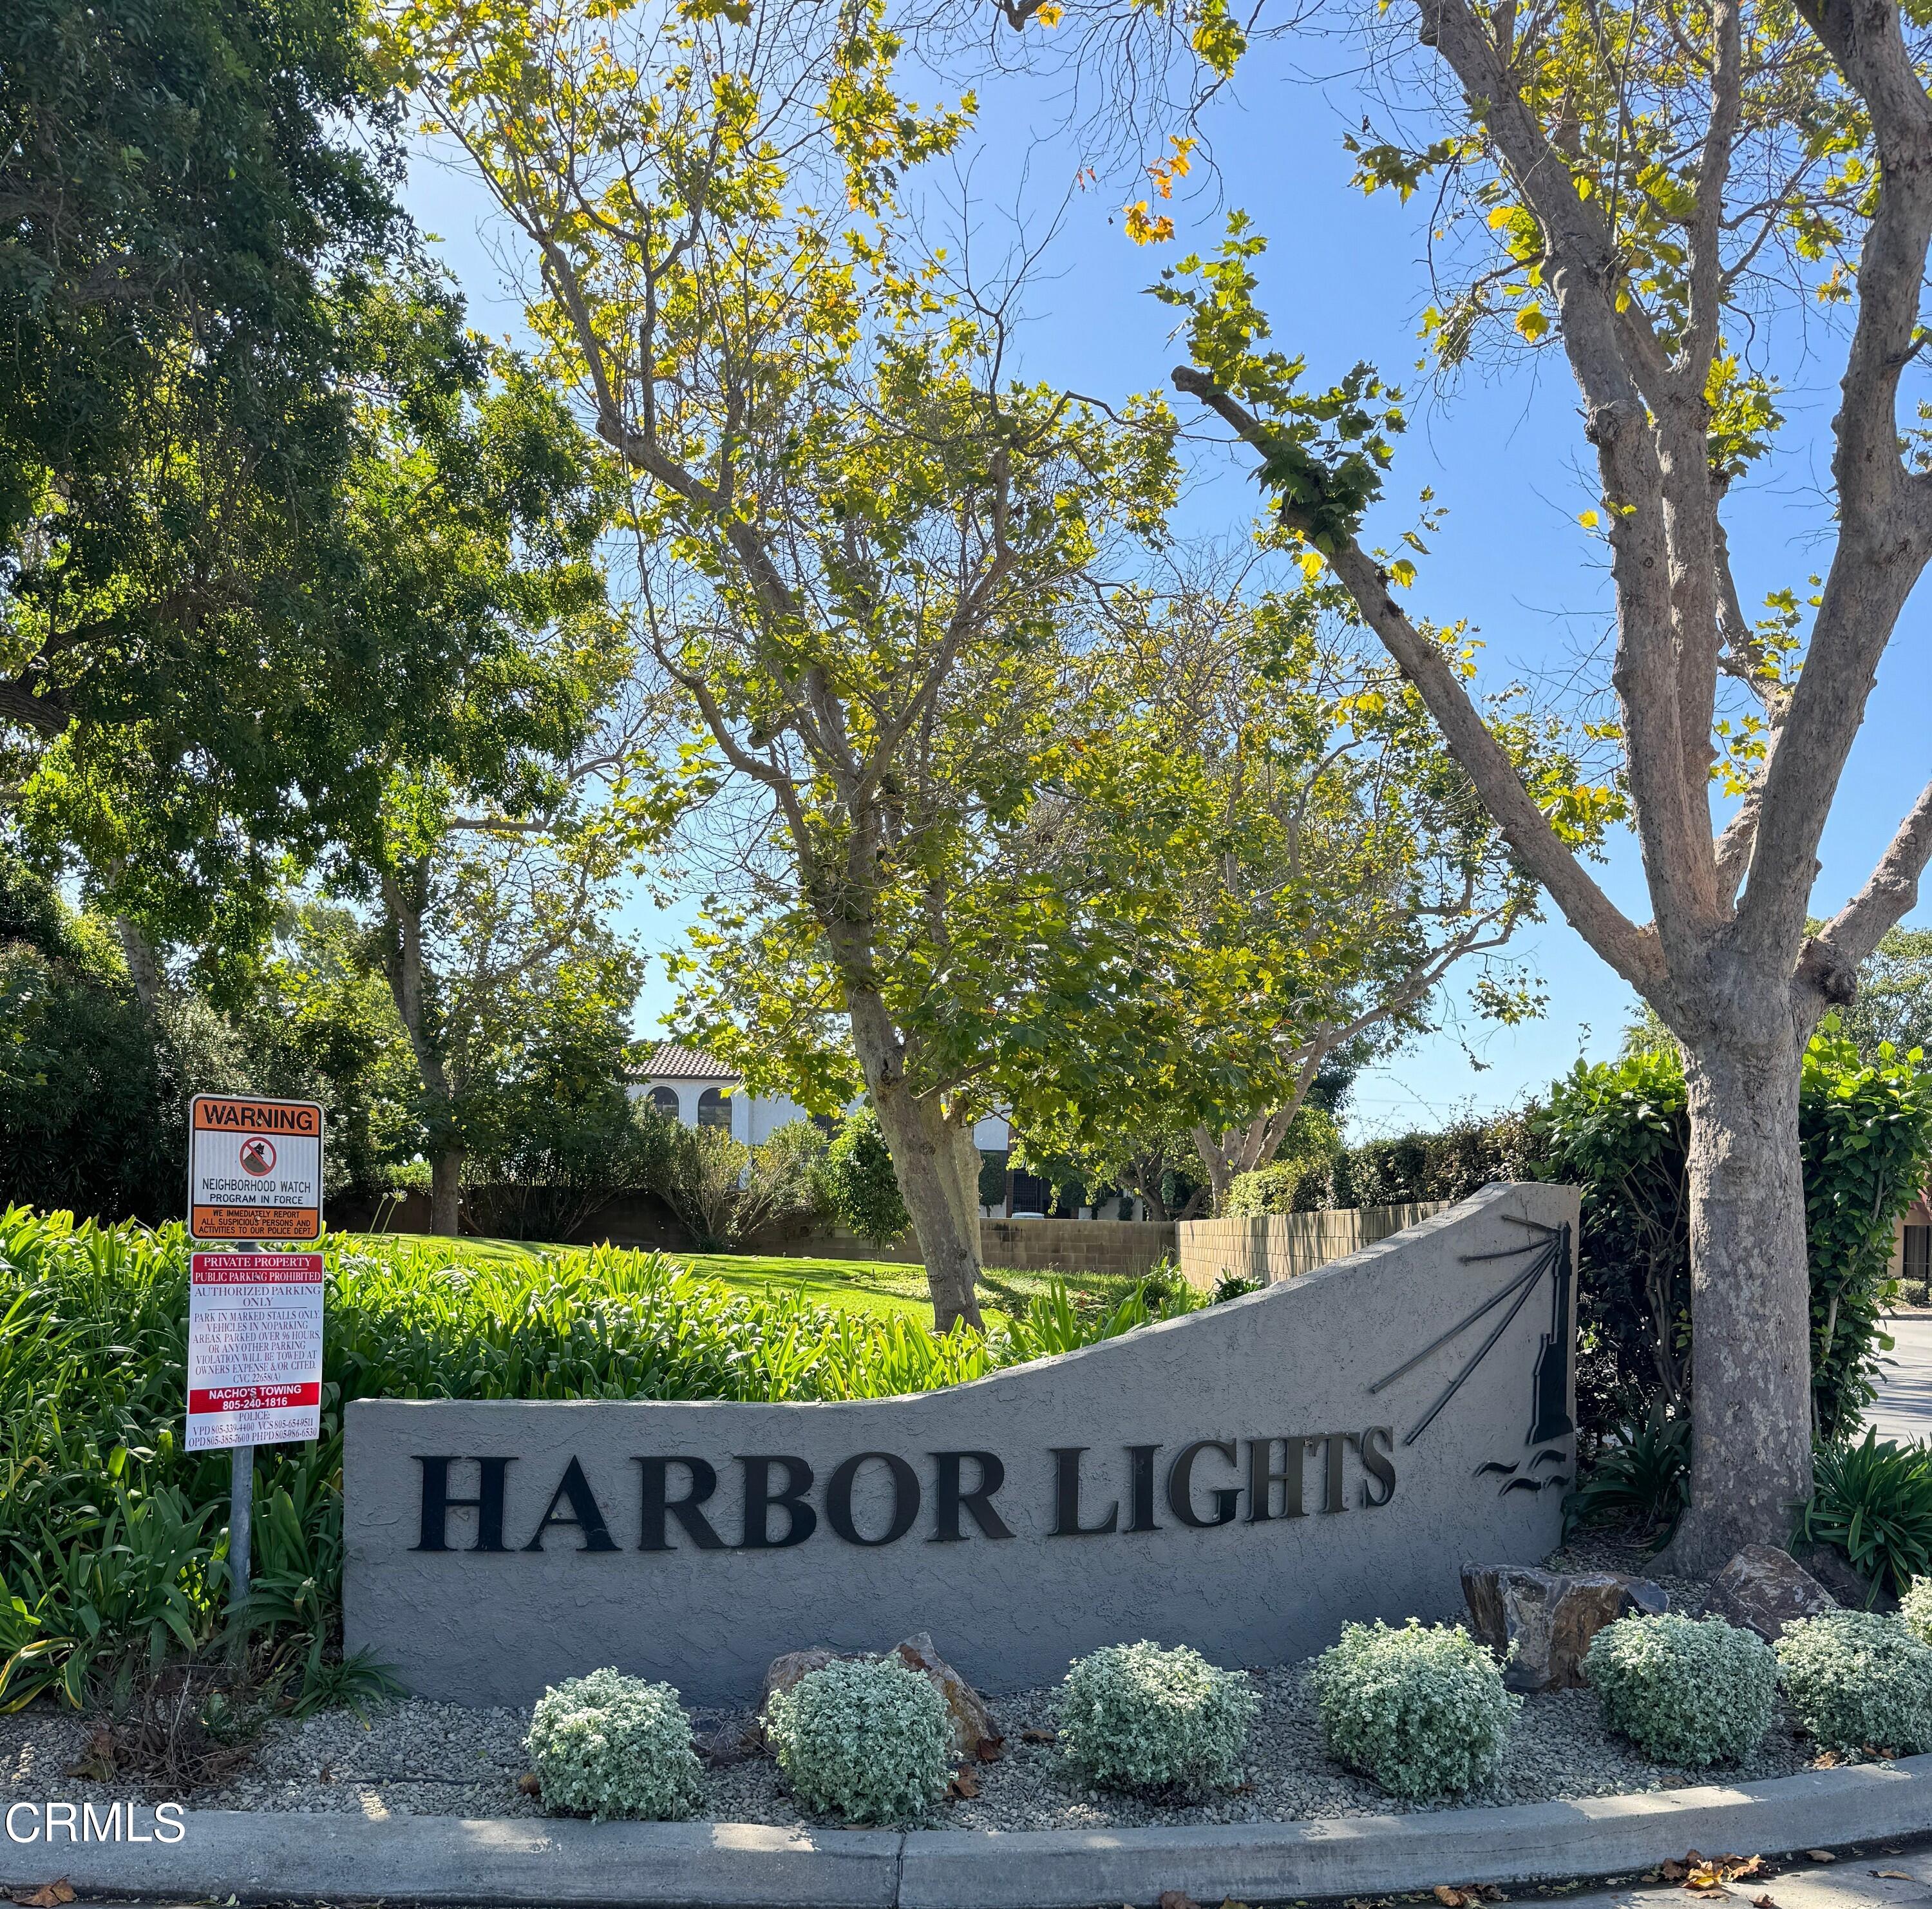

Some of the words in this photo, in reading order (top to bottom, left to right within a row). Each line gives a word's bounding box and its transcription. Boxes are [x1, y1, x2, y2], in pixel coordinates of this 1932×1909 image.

[204, 1104, 312, 1130] WARNING
[202, 1178, 276, 1192] NEIGHBORHOOD
[281, 1181, 310, 1193] WATCH
[210, 1193, 256, 1203] PROGRAM
[261, 1195, 269, 1204] IN
[274, 1195, 303, 1204] FORCE
[204, 1257, 251, 1267] PRIVATE
[254, 1257, 312, 1267] PROPERTY
[195, 1273, 227, 1282] PUBLIC
[269, 1271, 321, 1281] PROHIBITED
[194, 1287, 269, 1296] AUTHORIZED
[272, 1286, 321, 1295] PARKING
[243, 1297, 273, 1307] ONLY
[194, 1313, 215, 1323] PARK
[218, 1313, 227, 1322] IN
[231, 1311, 264, 1321] MARKED
[267, 1311, 296, 1320] STALLS
[299, 1310, 320, 1320] ONLY.
[207, 1322, 247, 1332] VEHICLES
[250, 1322, 258, 1331] IN
[193, 1334, 222, 1344] AREAS,
[225, 1333, 256, 1342] PARKED
[259, 1331, 279, 1341] OVER
[282, 1331, 290, 1340] 96
[292, 1330, 320, 1340] HOURS,
[209, 1344, 219, 1353] OR
[271, 1341, 305, 1351] PARKING
[196, 1354, 240, 1365] VIOLATION
[242, 1353, 262, 1362] WILL
[265, 1353, 274, 1361] BE
[276, 1351, 304, 1360] TOWED
[307, 1350, 317, 1359] AT
[196, 1365, 230, 1376] OWNERS
[232, 1363, 269, 1373] EXPENSE
[291, 1360, 316, 1370] CITED.
[233, 1374, 251, 1383] CVC
[209, 1388, 257, 1400] NACHO'S
[260, 1385, 301, 1396] TOWING
[223, 1397, 287, 1410] 805-240-1816
[239, 1410, 270, 1421] POLICE:
[407, 1451, 1017, 1552] HARBOR
[1048, 1426, 1396, 1536] LIGHTS
